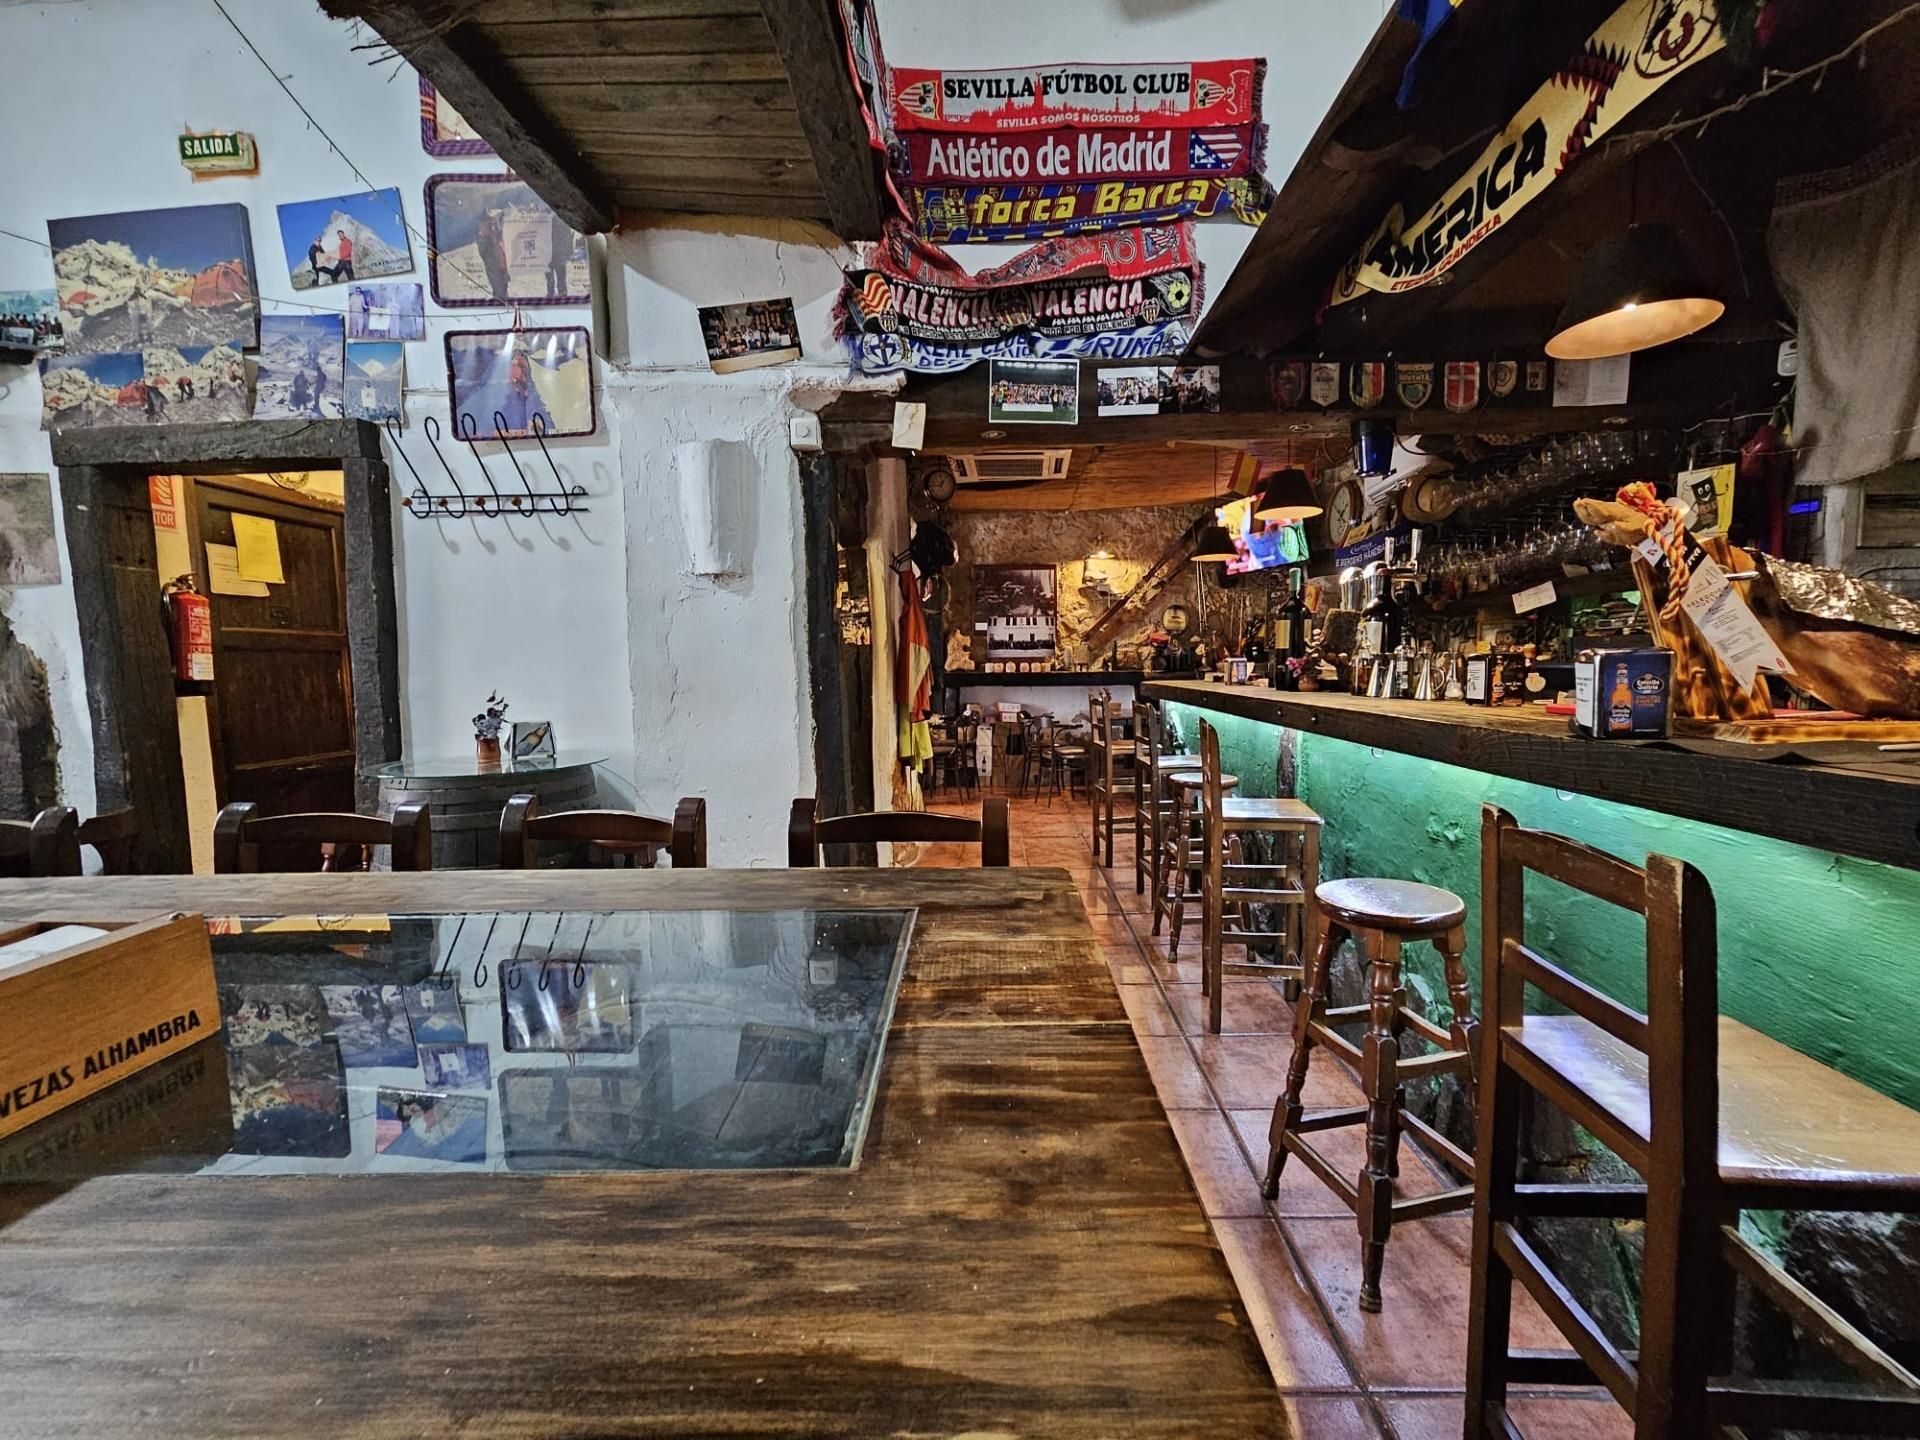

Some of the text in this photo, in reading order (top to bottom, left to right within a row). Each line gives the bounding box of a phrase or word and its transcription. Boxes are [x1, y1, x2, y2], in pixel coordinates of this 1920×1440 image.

[944, 69, 1190, 98] SEVILLA FÚTBOL CLUB
[996, 112, 1140, 128] SEVILLA SOMOS NOSOTROS
[183, 137, 234, 156] SALIDA
[926, 129, 1172, 179] Atlético de Madrid
[1364, 117, 1547, 278] AMÉRICA
[1438, 213, 1502, 272] GRANDEZA
[889, 280, 1143, 327] VALENCIA VALENCIA
[1082, 323, 1096, 333] EL
[1096, 318, 1137, 332] VALENCIA
[83, 1009, 201, 1080] ALHAMBRA
